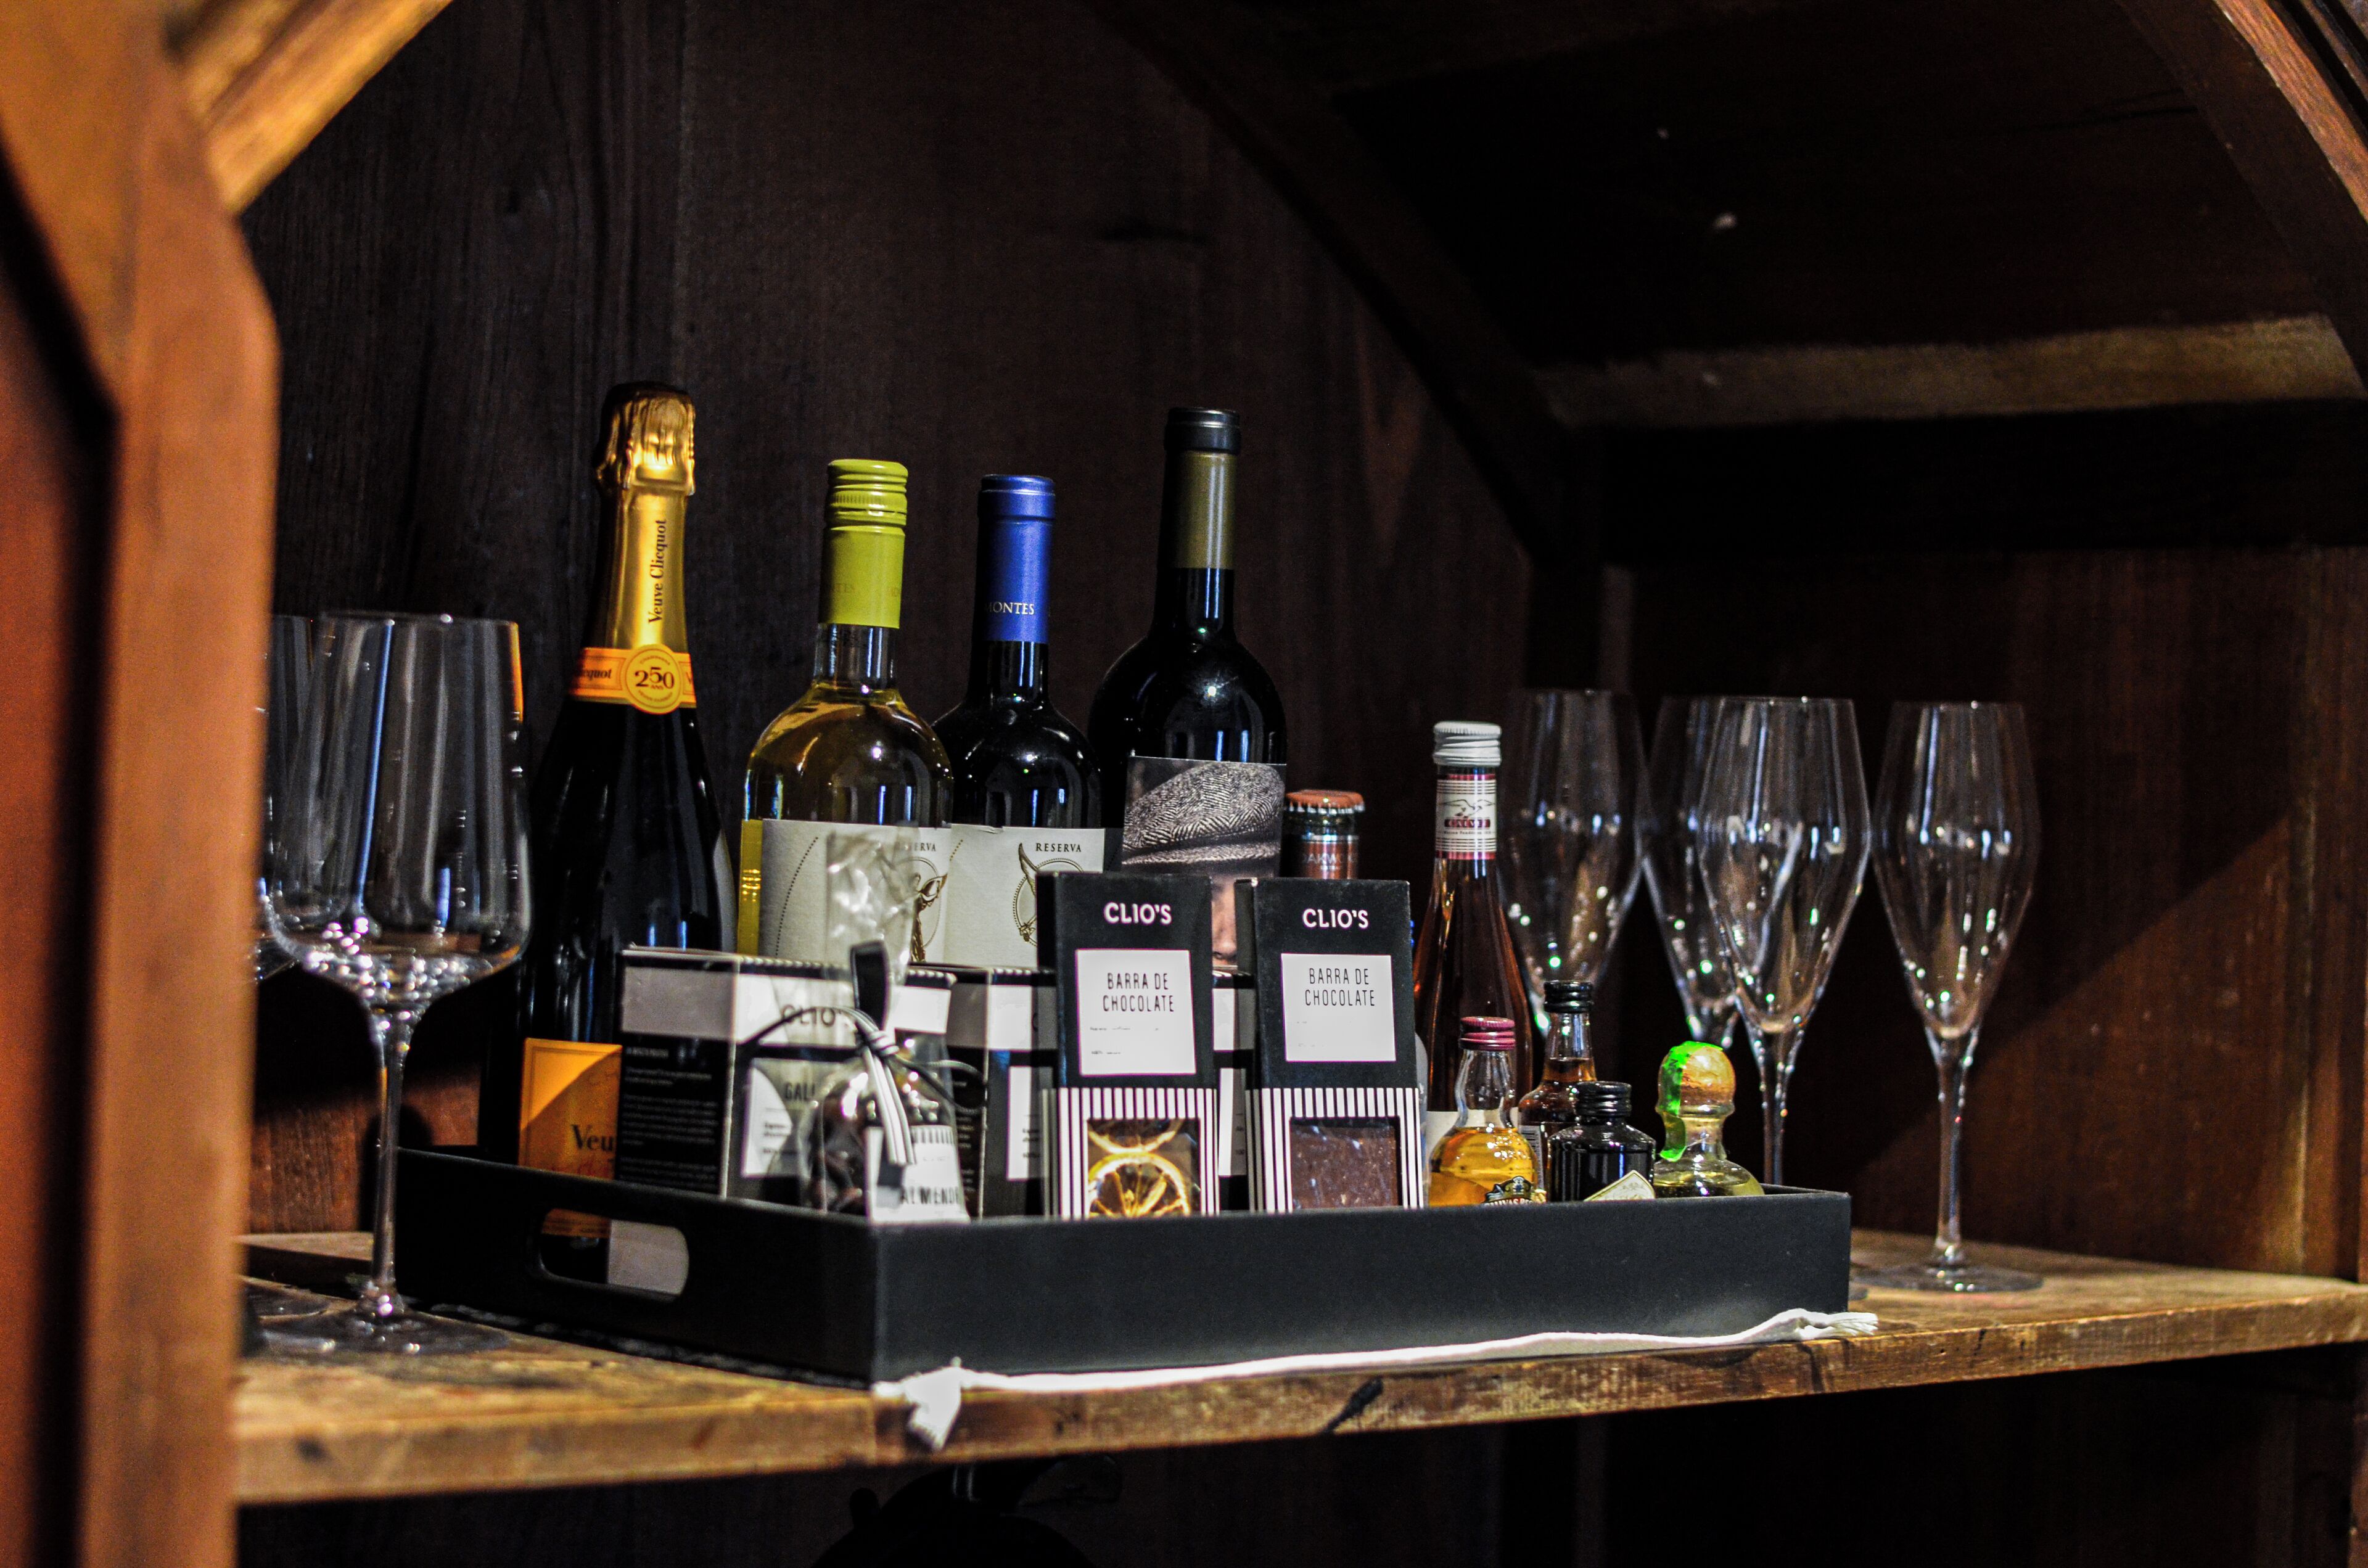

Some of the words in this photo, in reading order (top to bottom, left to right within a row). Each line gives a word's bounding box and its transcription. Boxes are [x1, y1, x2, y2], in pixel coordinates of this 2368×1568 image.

[649, 519, 667, 578] Clicquot
[648, 583, 663, 624] Veuve
[635, 667, 675, 689] 250
[1035, 842, 1082, 852] RESERVA
[1104, 902, 1172, 924] CLIO'S
[1302, 908, 1369, 929] CLIO'S
[1107, 972, 1148, 990] BARRA
[1154, 973, 1169, 990] DE
[1309, 967, 1349, 985] BARRA
[1355, 968, 1369, 985] DE
[1103, 994, 1174, 1012] CHOCOLATE
[1305, 988, 1375, 1006] CHOCOLATE
